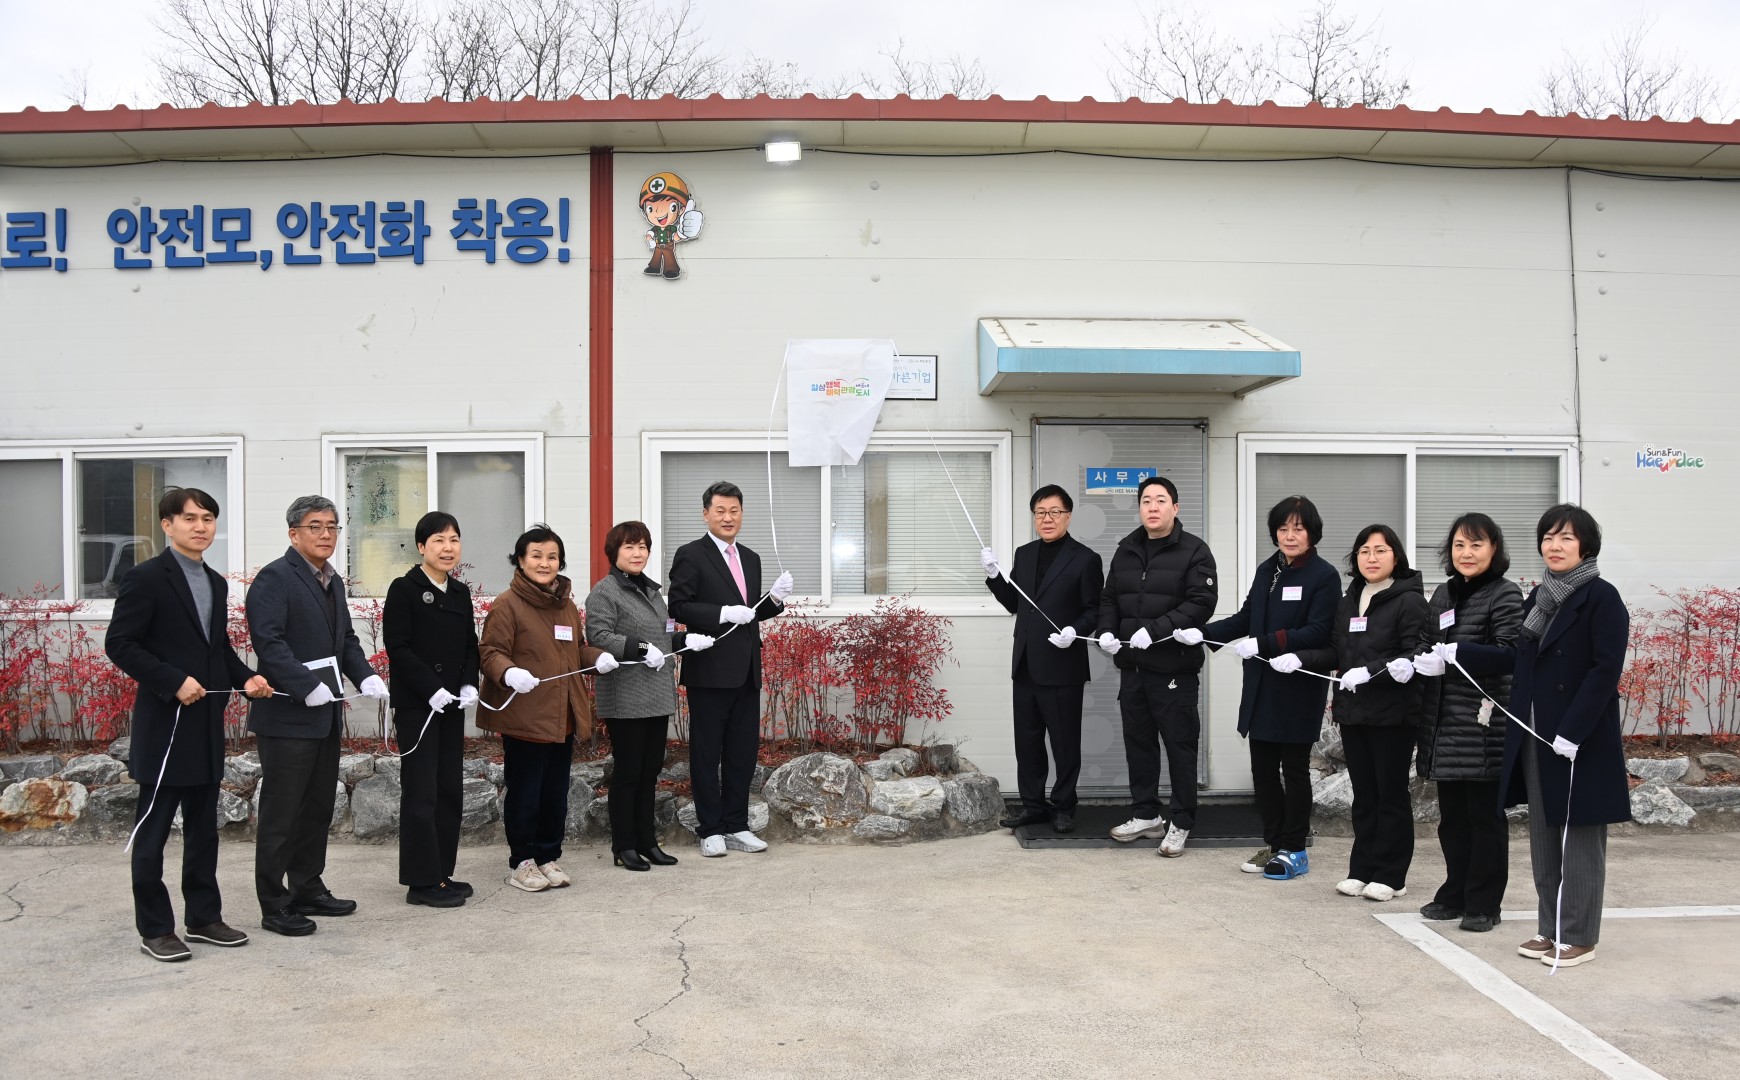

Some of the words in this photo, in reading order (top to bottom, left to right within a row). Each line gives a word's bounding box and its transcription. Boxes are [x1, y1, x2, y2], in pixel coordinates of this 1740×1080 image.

[0, 207, 68, 272] 로!
[449, 197, 570, 264] 착용!
[1636, 451, 1704, 473] Haeundae
[1646, 447, 1683, 457] Sun&Fun
